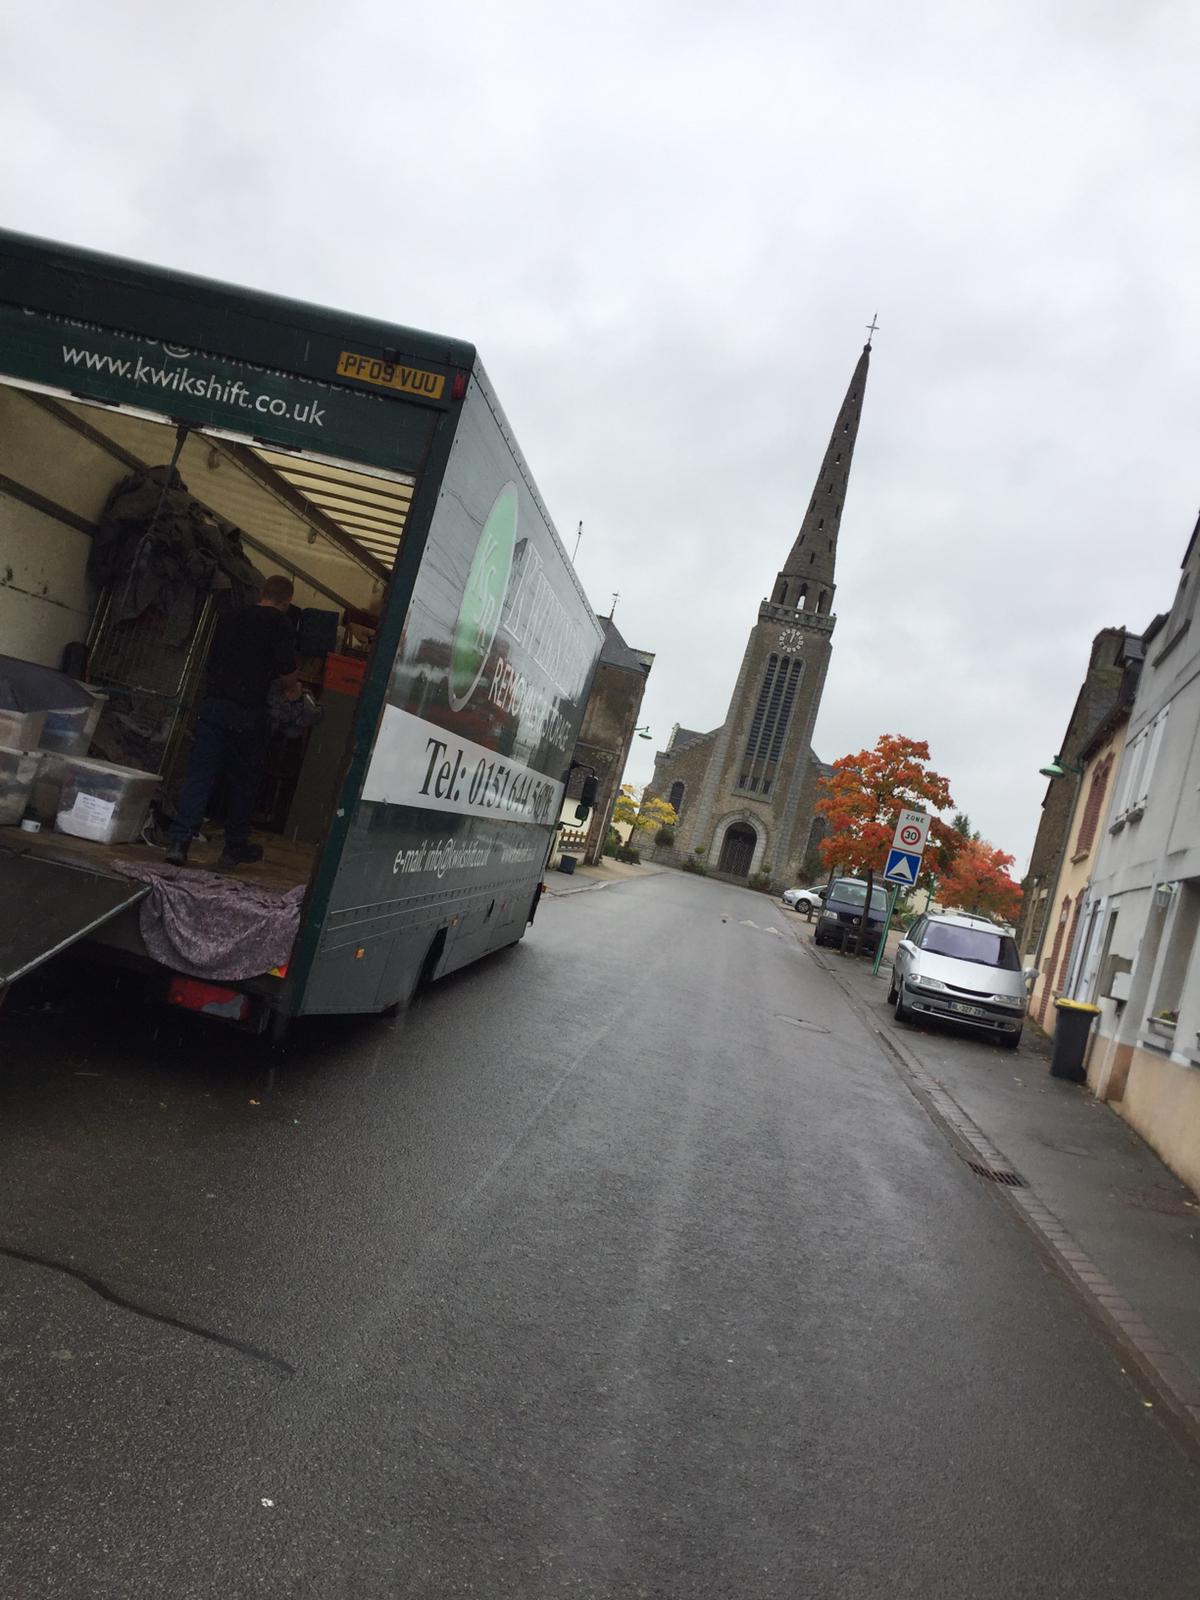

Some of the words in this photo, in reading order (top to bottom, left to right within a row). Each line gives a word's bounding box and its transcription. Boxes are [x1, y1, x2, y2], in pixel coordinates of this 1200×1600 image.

[61, 345, 326, 427] www.kwikshift.co.uk
[343, 355, 395, 383] PF09
[400, 371, 438, 394] VUU
[418, 737, 467, 801] Tel:
[468, 758, 511, 808] 0151
[507, 773, 534, 813] 644
[905, 831, 917, 840] 30
[906, 814, 924, 823] ZONE
